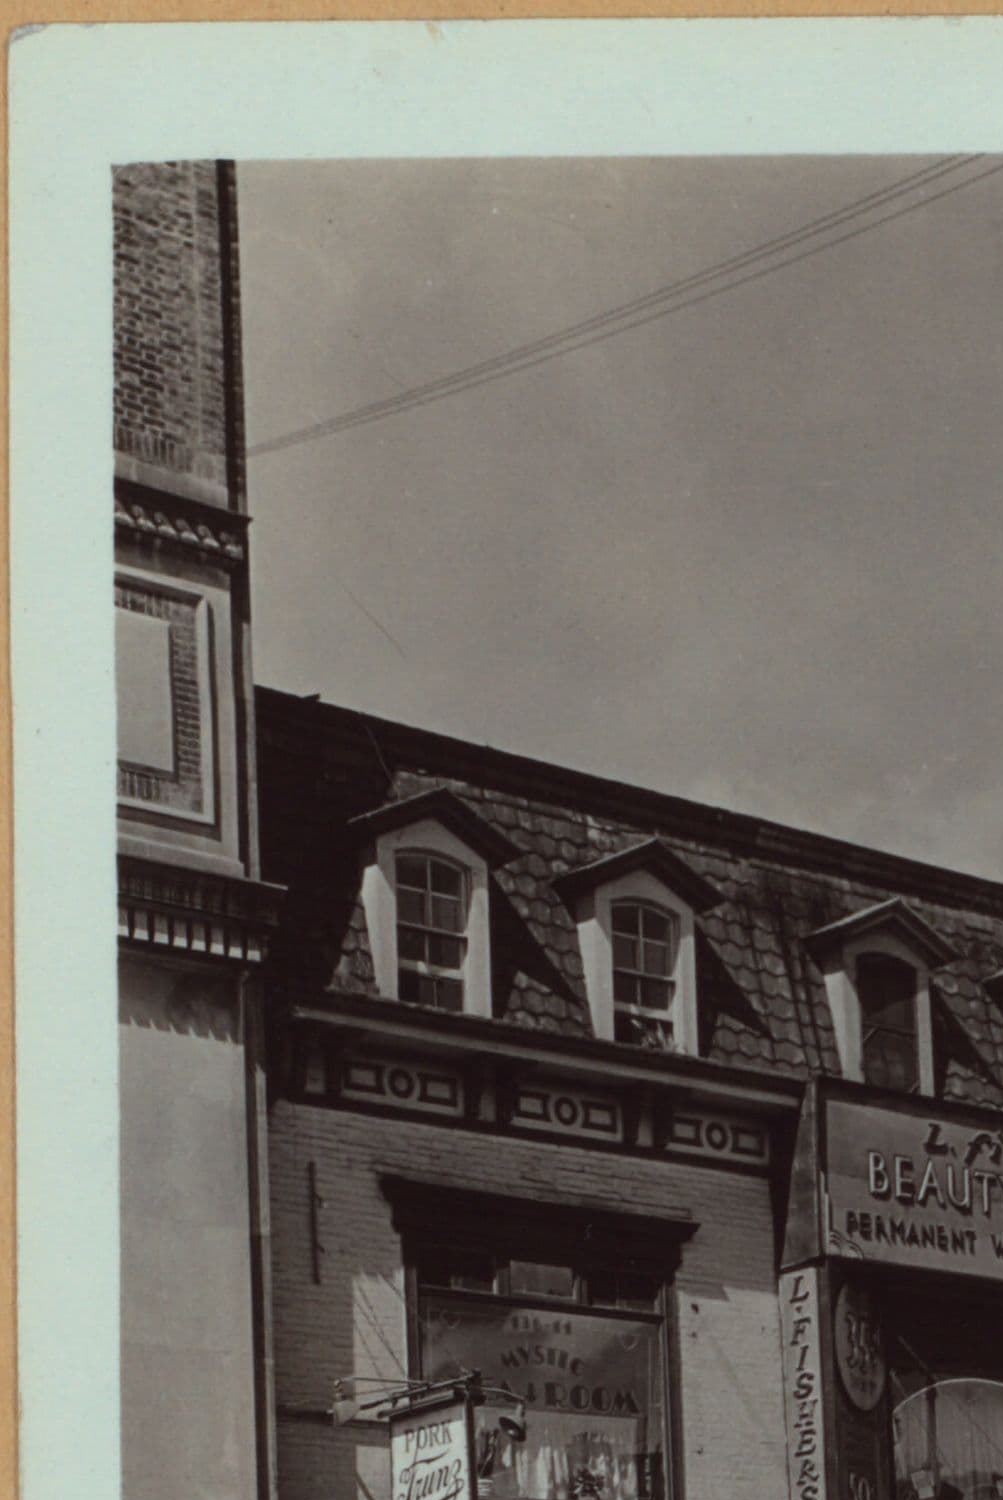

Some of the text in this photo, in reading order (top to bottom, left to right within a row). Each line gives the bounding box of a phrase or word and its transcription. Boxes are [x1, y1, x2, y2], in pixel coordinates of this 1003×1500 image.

[845, 1210, 977, 1256] PERMANENT
[545, 1382, 641, 1415] ROOM
[404, 1420, 453, 1454] PORK
